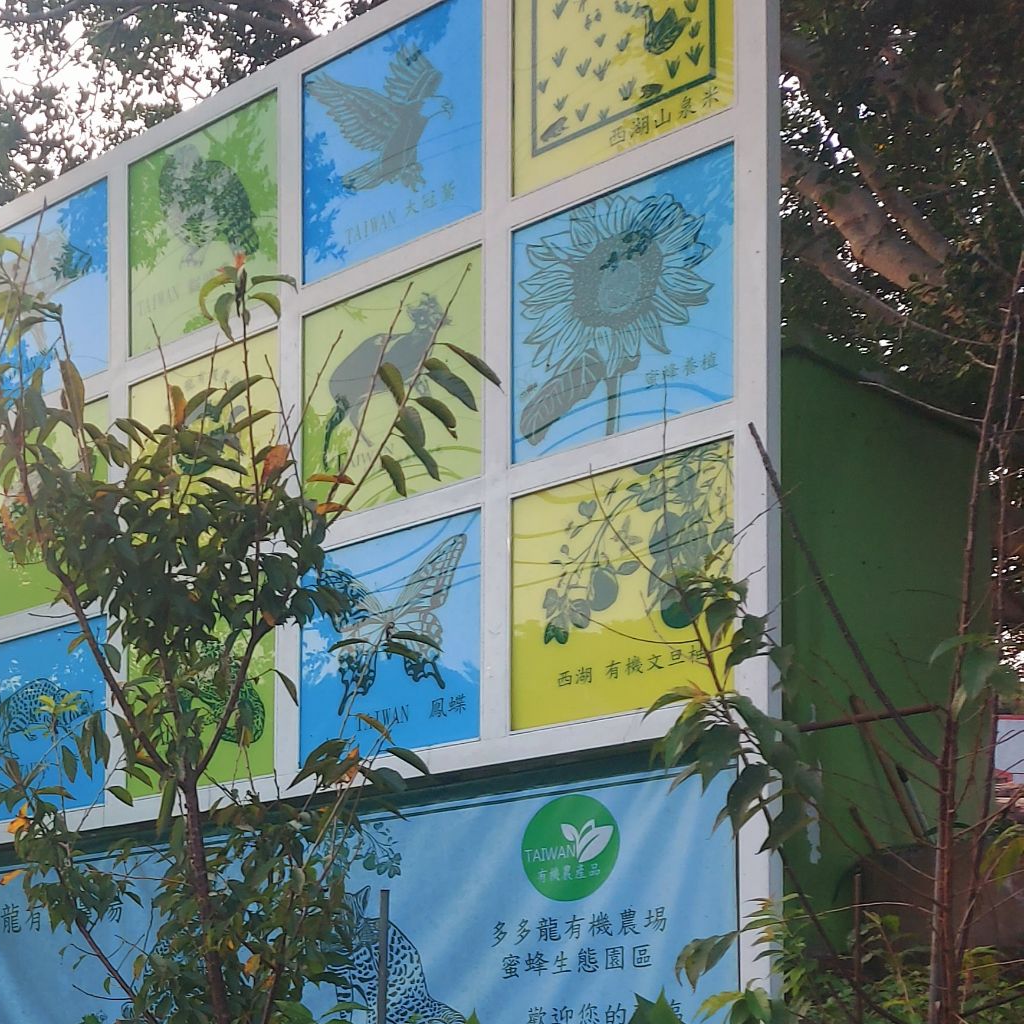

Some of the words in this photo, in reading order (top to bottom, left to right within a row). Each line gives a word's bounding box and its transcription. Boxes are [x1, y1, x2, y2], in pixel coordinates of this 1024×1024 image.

[609, 86, 720, 147] 西湖山泉米
[344, 208, 398, 246] TAIWAN
[557, 666, 593, 689] 西湖
[428, 693, 468, 719] 鳳蝶
[523, 844, 576, 863] TAIWAN
[490, 906, 668, 948] 多多龍有機農場
[501, 944, 653, 980] 蜜蜂生態園區
